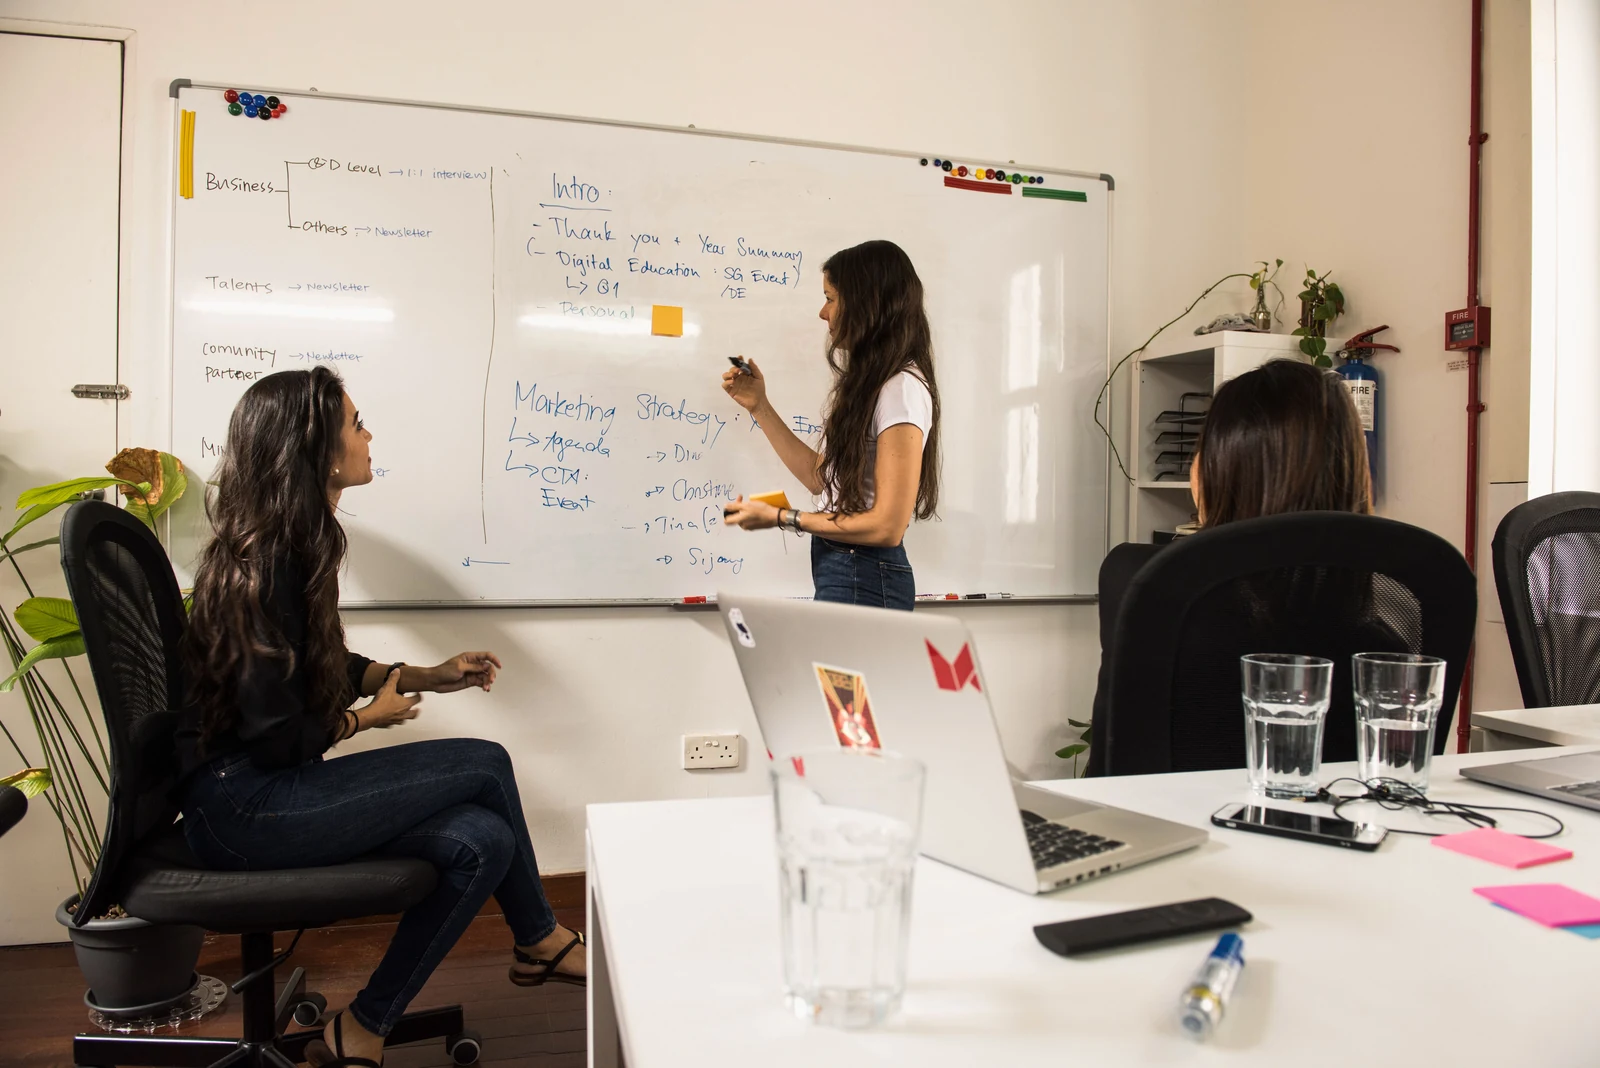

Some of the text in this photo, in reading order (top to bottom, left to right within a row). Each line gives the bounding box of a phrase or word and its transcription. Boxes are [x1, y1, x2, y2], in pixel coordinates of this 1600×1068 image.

[347, 162, 382, 177] Level
[432, 169, 487, 180] interview
[205, 172, 275, 193] Business
[375, 226, 433, 239] Newsletter
[549, 217, 617, 242] Thank
[631, 234, 660, 253] you
[699, 234, 726, 256] Year
[737, 237, 803, 262] Summary
[556, 251, 613, 276] Digital
[724, 267, 743, 282] SG
[205, 276, 273, 294] Talents
[307, 283, 371, 293] Newsletter
[559, 301, 635, 320] Personal
[1452, 311, 1469, 321] FIRE
[1350, 386, 1370, 395] FIRE
[514, 380, 616, 436] Marketing
[540, 487, 596, 511] Event
